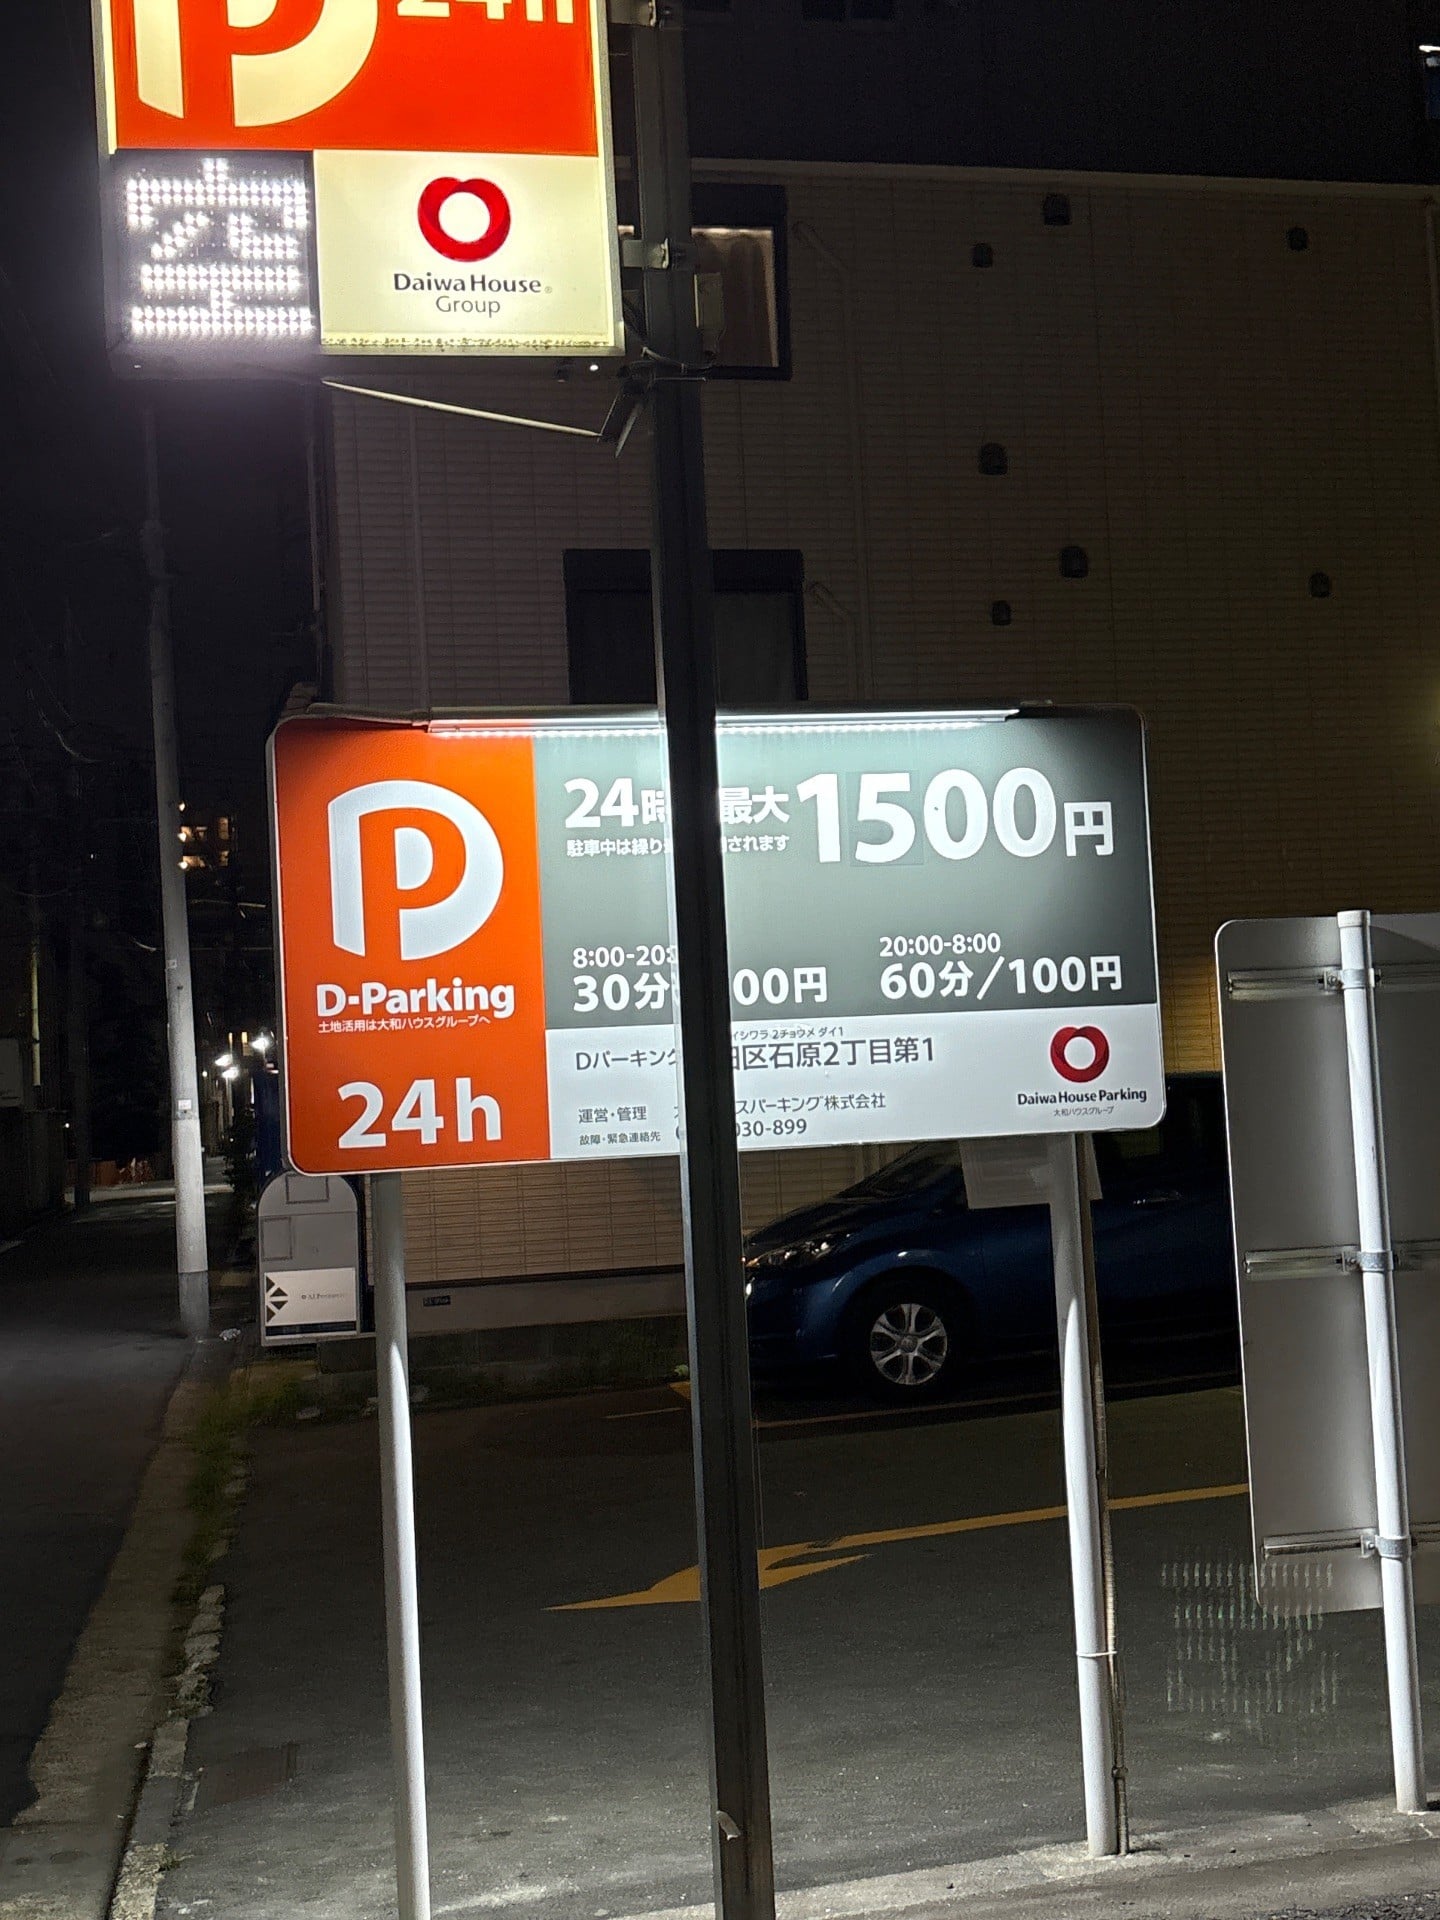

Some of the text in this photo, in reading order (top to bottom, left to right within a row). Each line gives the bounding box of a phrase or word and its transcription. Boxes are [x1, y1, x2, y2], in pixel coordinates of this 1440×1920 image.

[393, 272, 542, 294] Daiwa House
[435, 296, 501, 318] Group
[878, 931, 1002, 958] 20:00-8:00
[316, 977, 515, 1019] D-Parking
[318, 1013, 491, 1034] 土地活用は大和ハウスグループへ
[1017, 1087, 1148, 1106] Daiwa House Parking
[337, 1077, 502, 1149] 24h
[578, 1105, 648, 1124] 運営・管理
